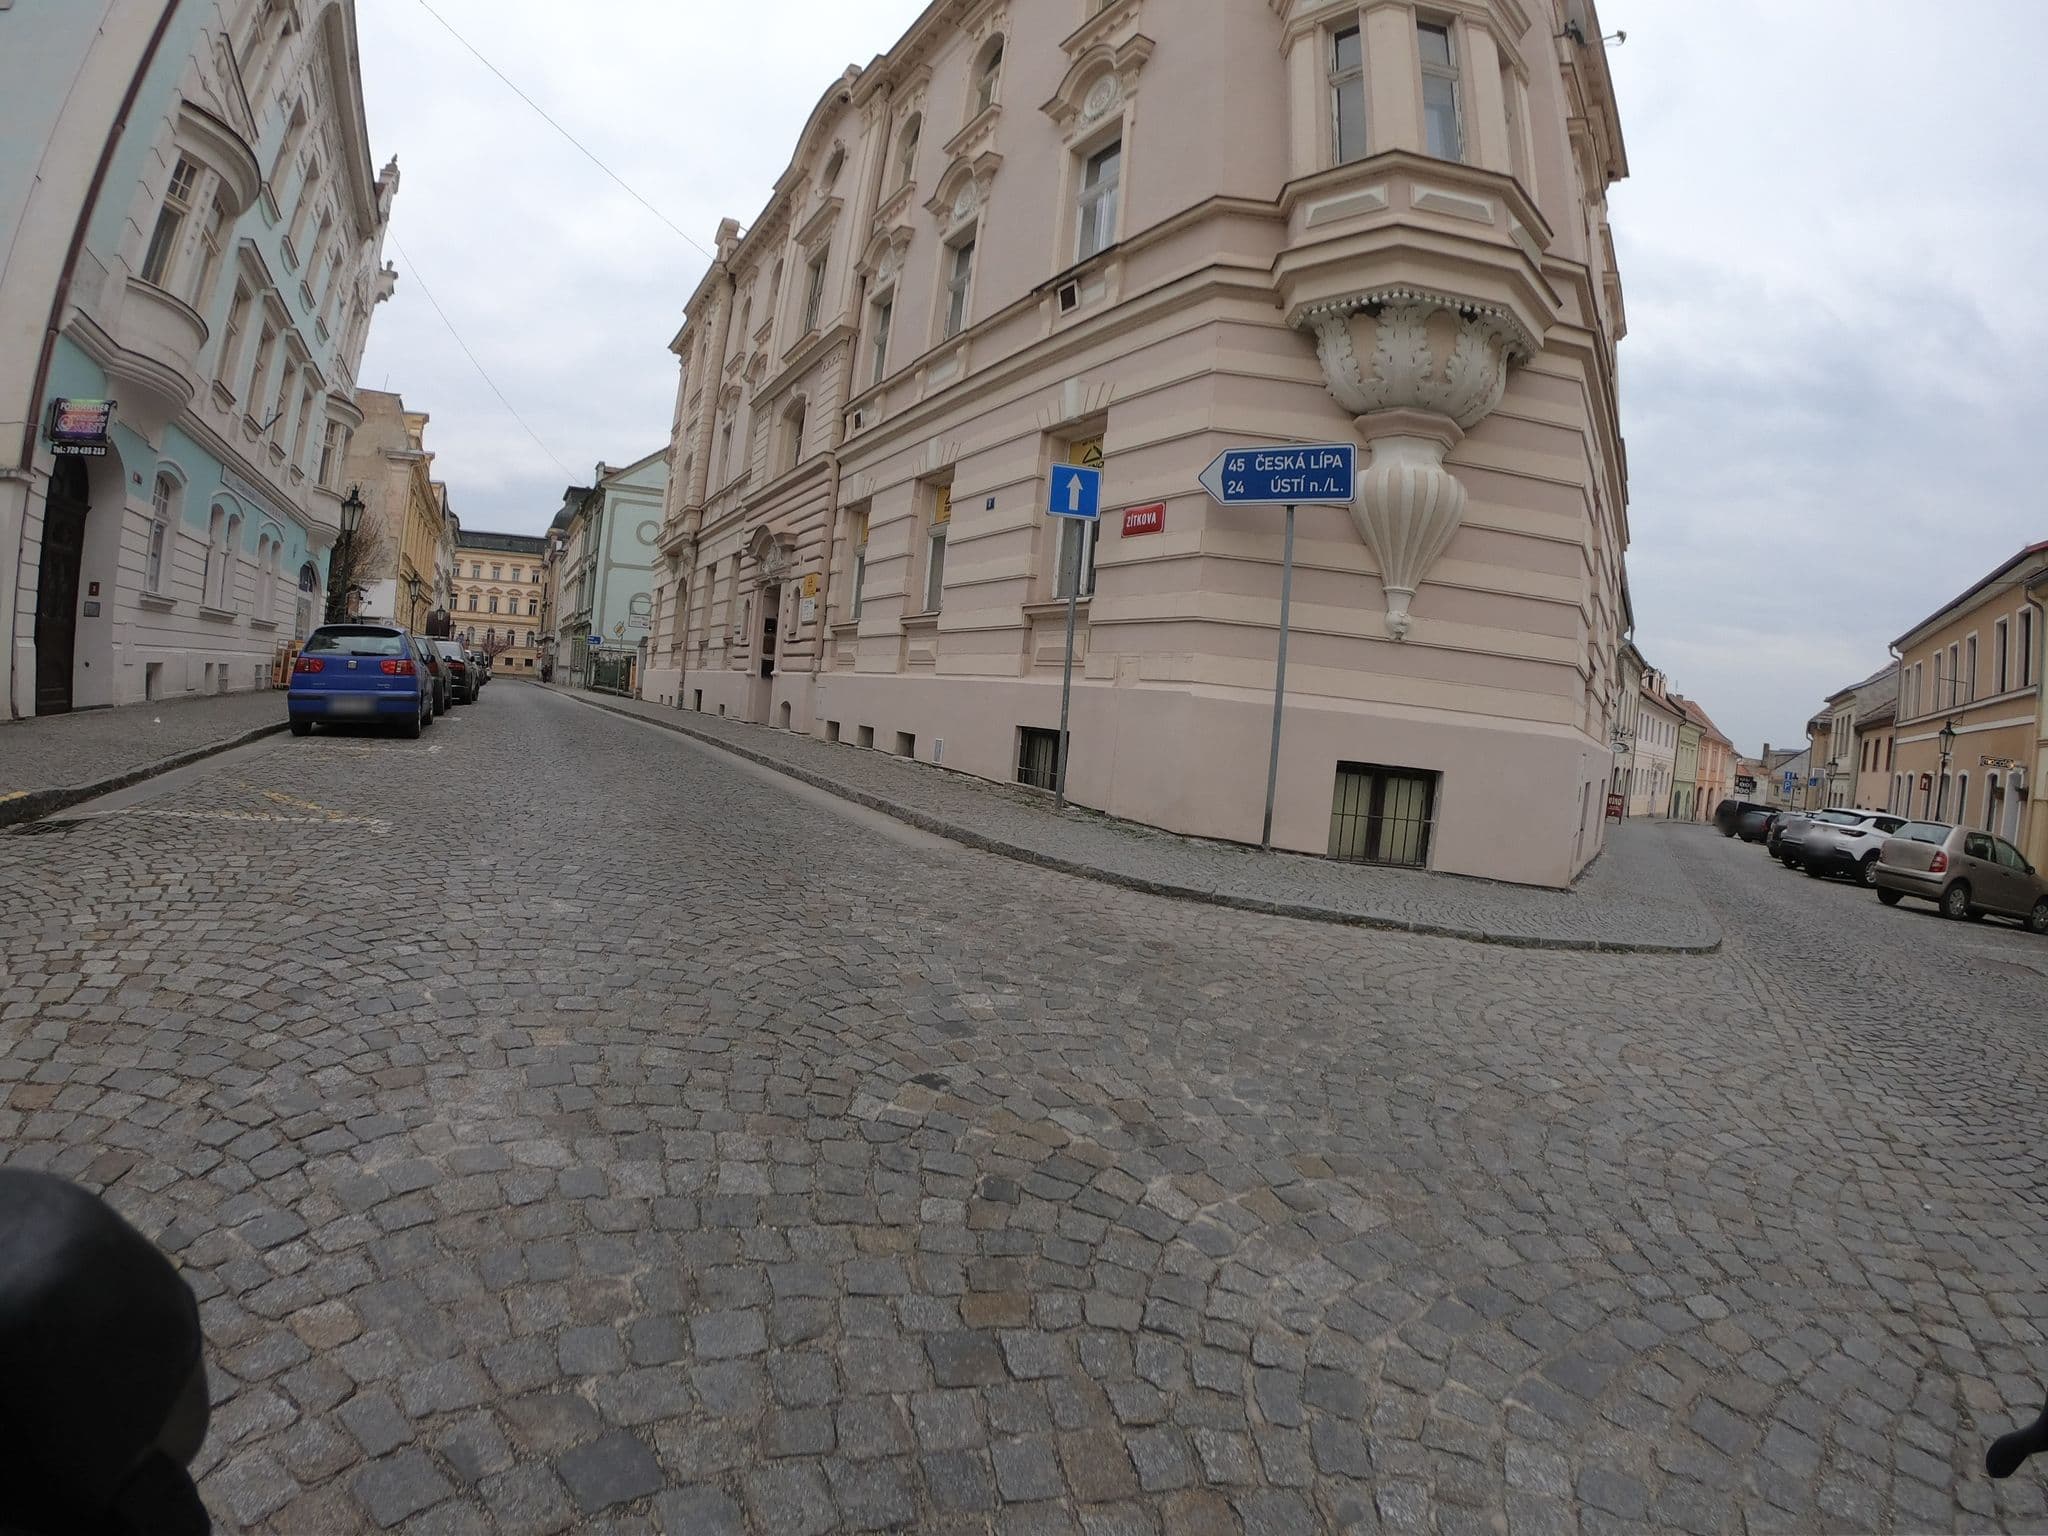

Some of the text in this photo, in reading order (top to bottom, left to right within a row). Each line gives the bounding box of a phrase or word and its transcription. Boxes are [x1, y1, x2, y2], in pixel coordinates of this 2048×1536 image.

[1228, 451, 1343, 472] 45 ČESKÁ LÍPA
[1227, 475, 1344, 494] 24 ÚSTÍ n./L.
[1126, 512, 1157, 528] ZÍTKOVA
